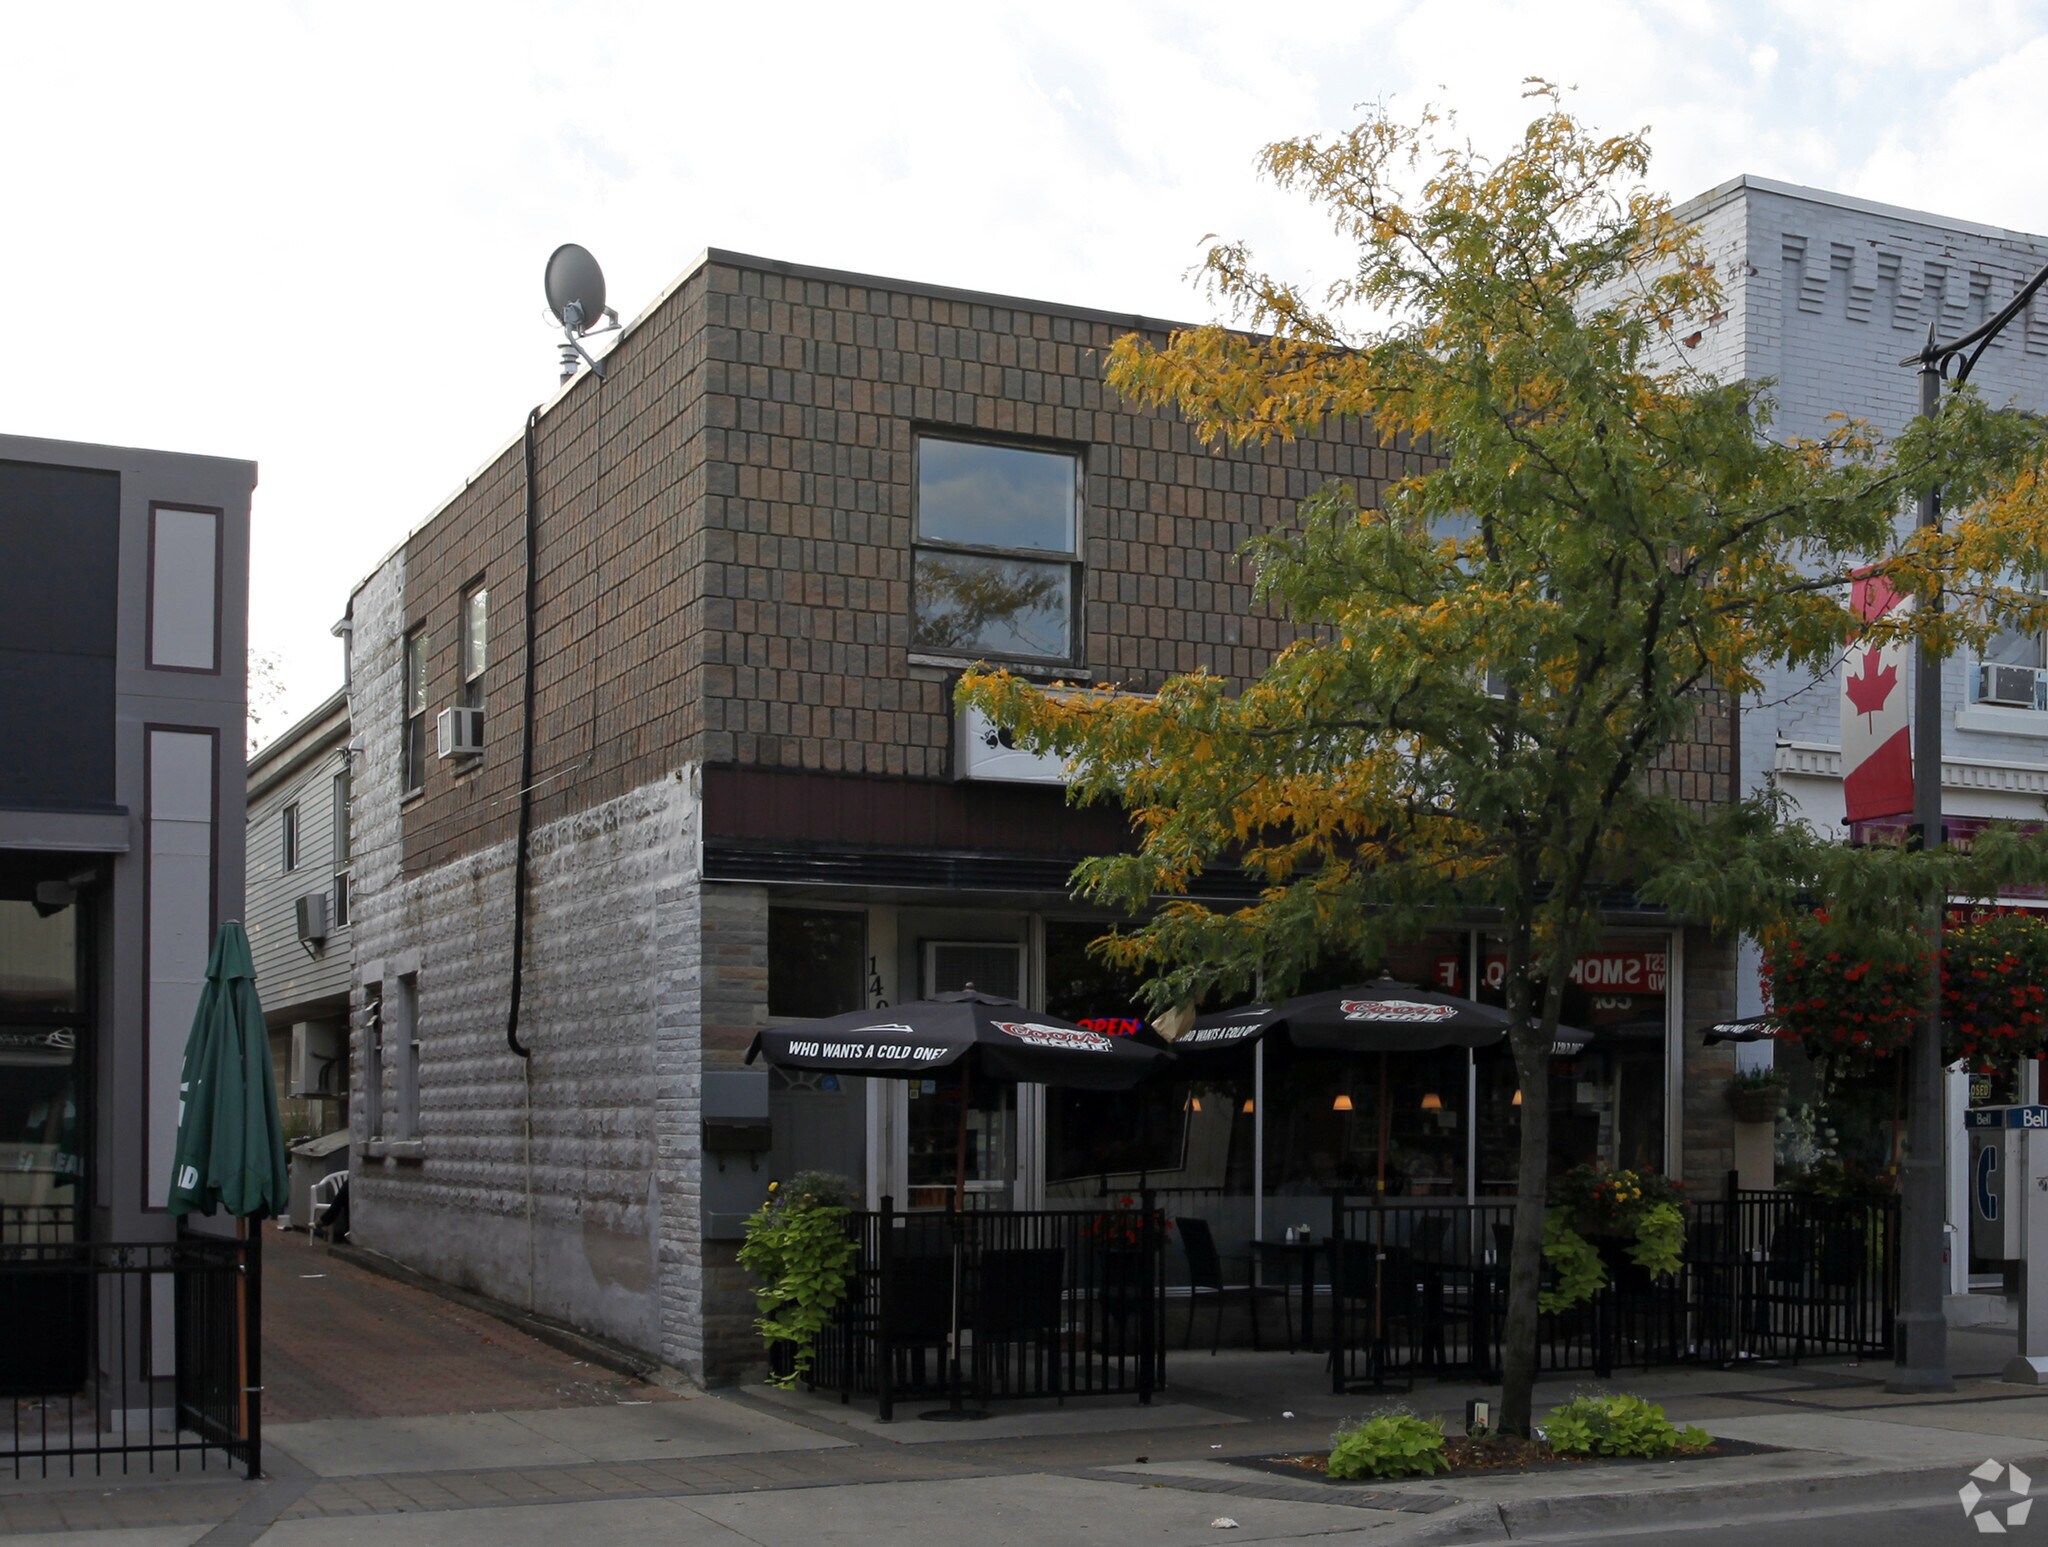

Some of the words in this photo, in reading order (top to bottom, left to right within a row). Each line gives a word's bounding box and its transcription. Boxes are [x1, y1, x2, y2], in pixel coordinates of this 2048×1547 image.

[1195, 1028, 1221, 1042] WANTS
[1217, 1027, 1226, 1040] A
[788, 1041, 819, 1057] WHO
[822, 1043, 864, 1058] WANTS
[865, 1044, 874, 1058] A
[877, 1045, 912, 1059] COLD
[913, 1047, 948, 1061] ONE?
[1976, 1113, 1991, 1125] Bell
[2023, 1109, 2048, 1127] Bell
